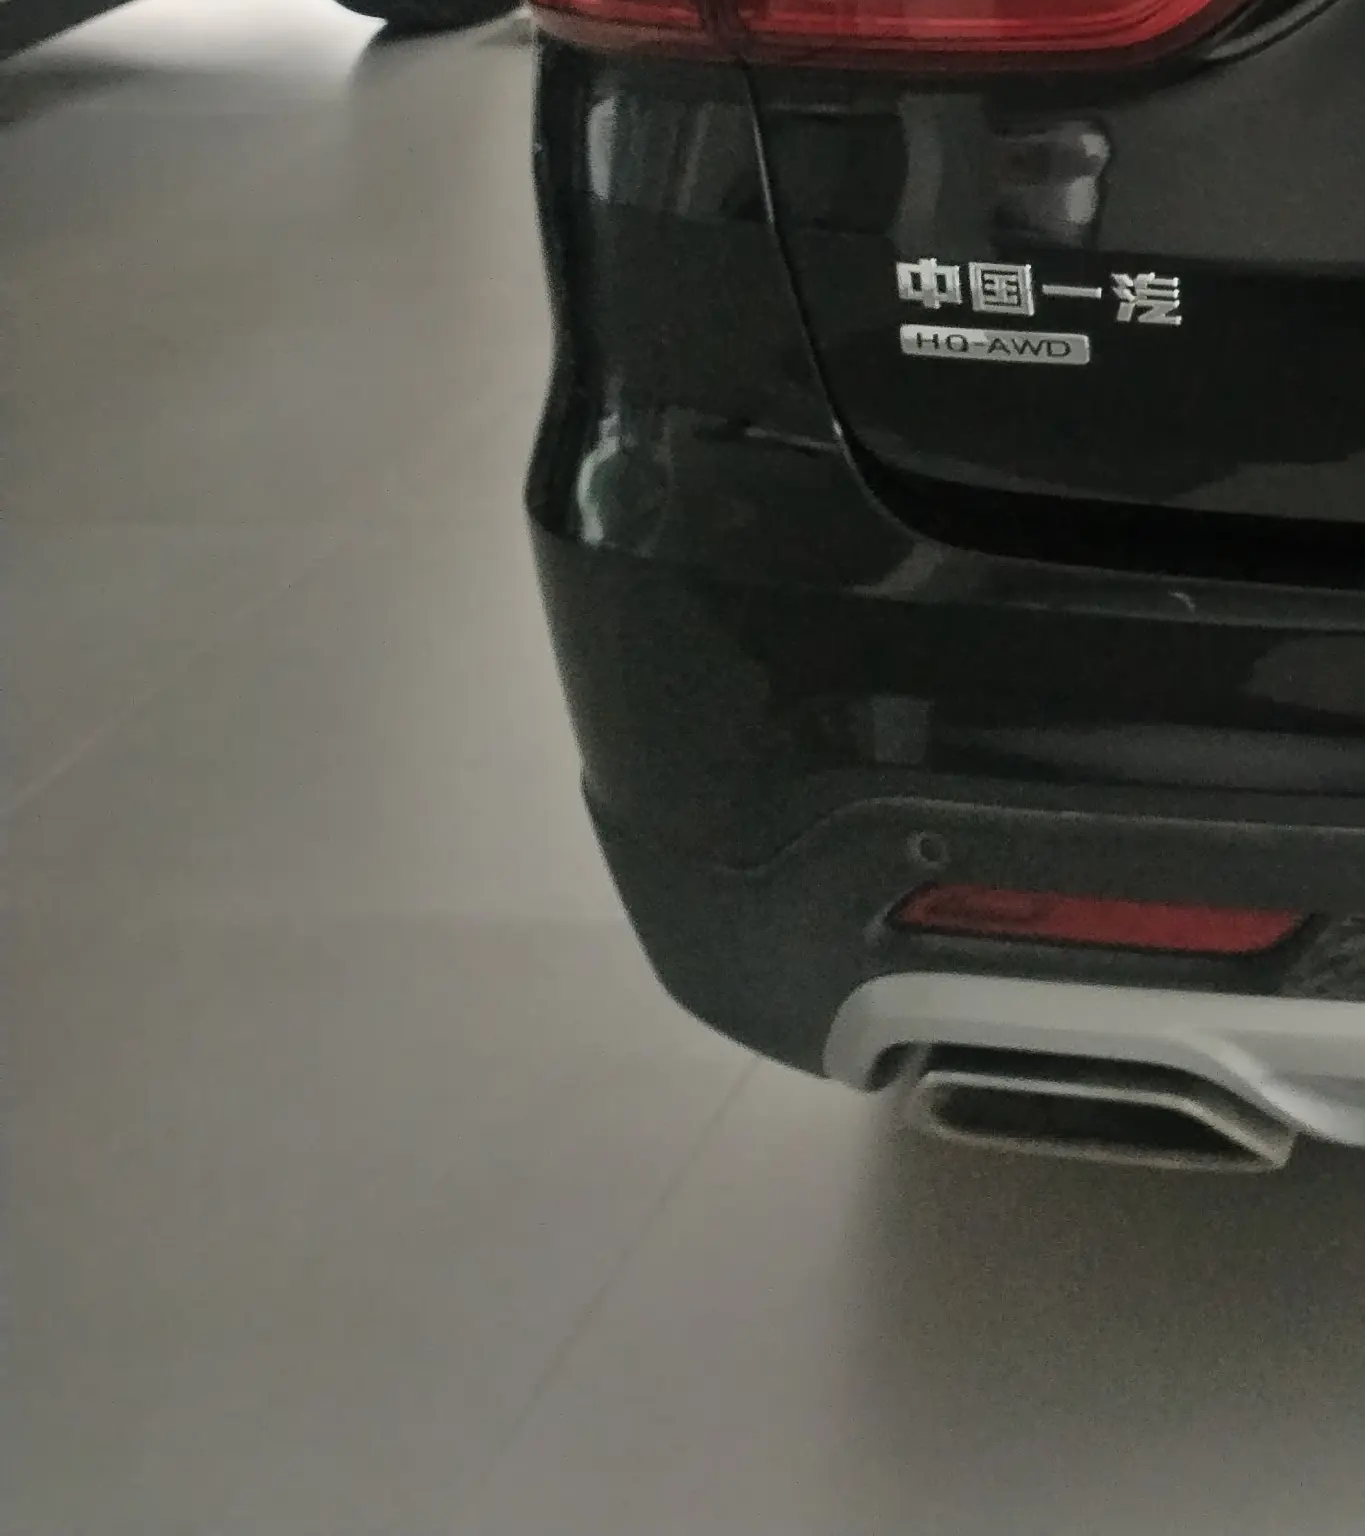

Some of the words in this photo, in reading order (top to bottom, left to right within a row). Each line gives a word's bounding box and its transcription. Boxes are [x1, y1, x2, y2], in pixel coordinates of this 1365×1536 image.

[896, 258, 1182, 326] 中国一汽
[915, 331, 1072, 358] HQ-AWD
